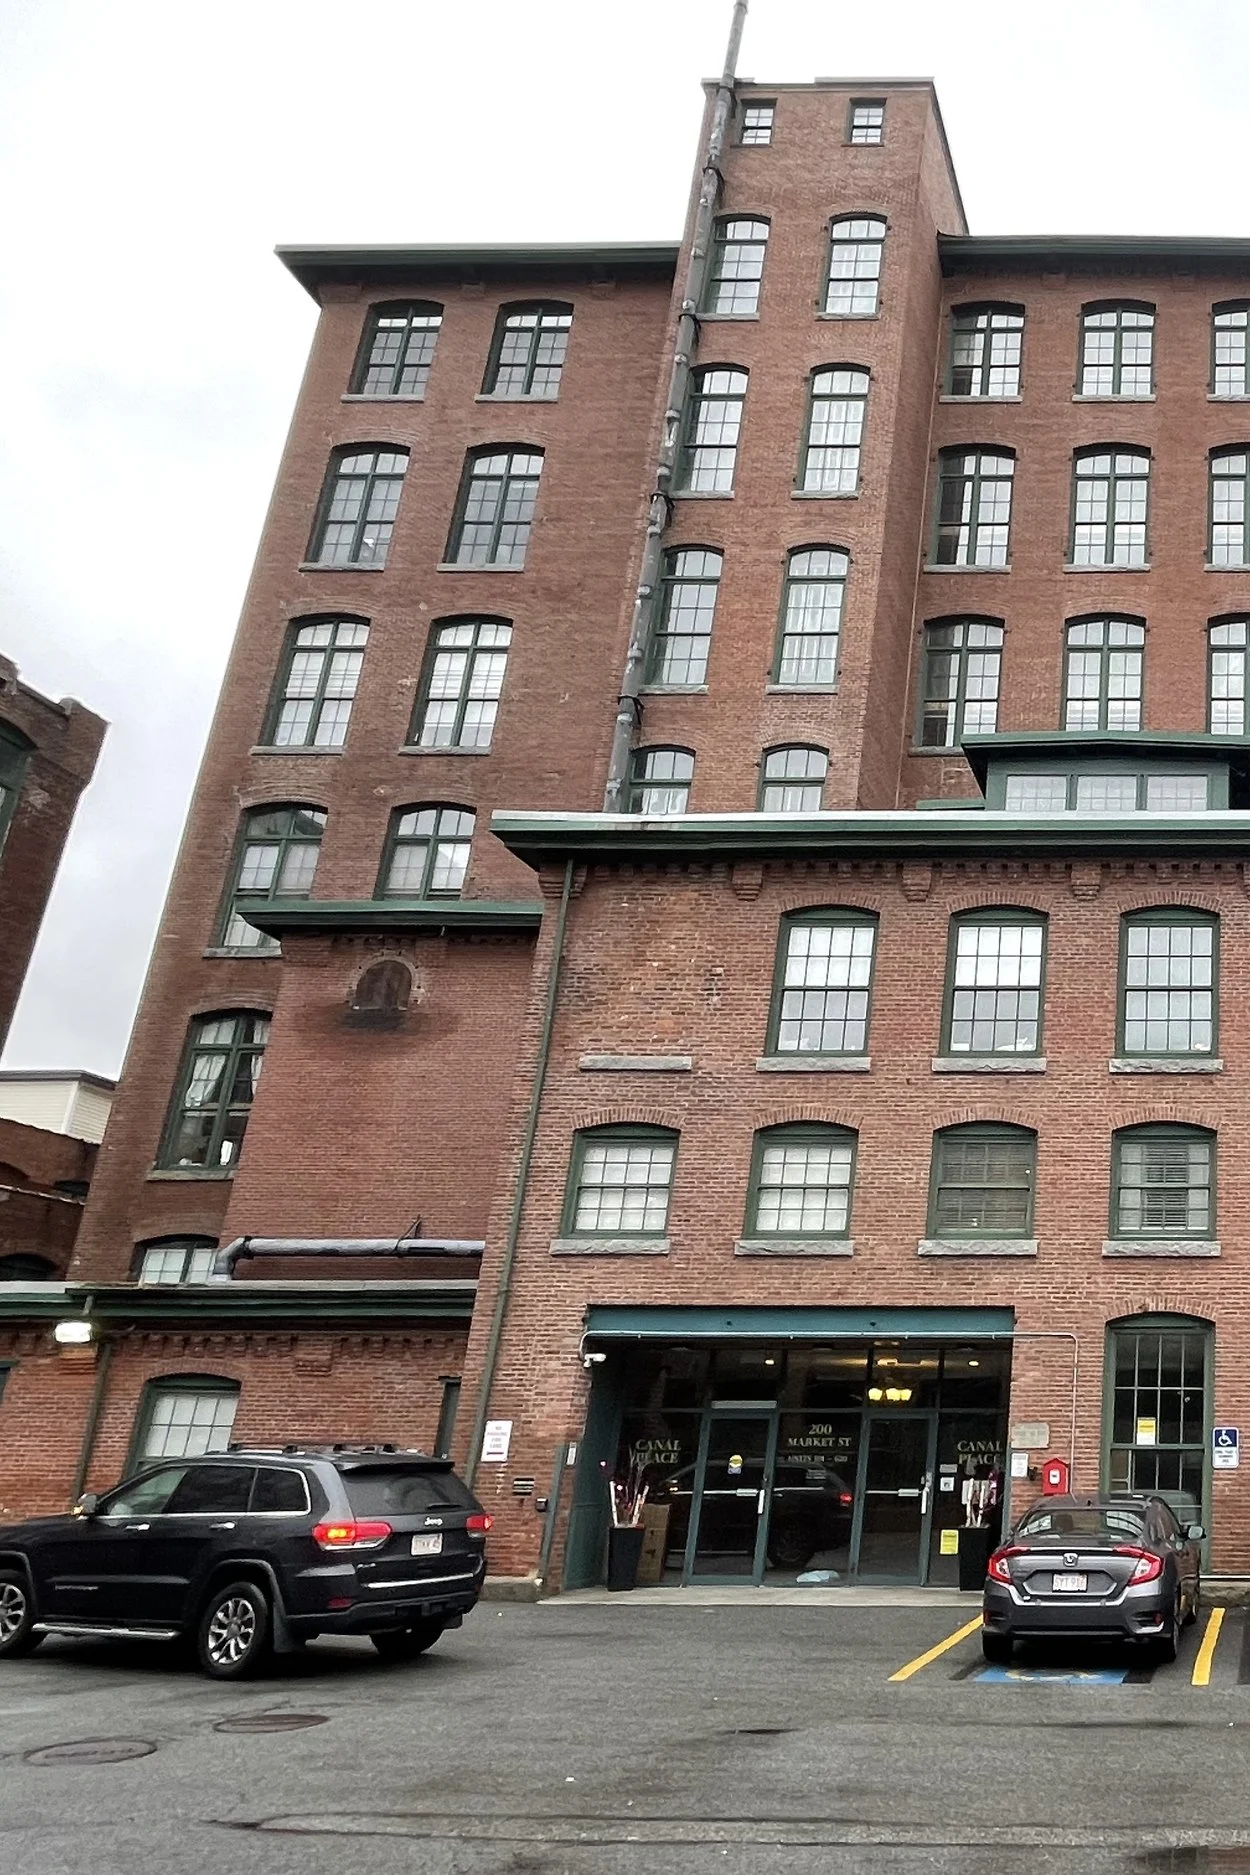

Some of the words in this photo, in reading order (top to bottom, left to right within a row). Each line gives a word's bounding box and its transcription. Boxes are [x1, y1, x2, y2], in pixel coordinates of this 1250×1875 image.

[809, 1424, 832, 1435] 200
[635, 1439, 681, 1450] CANAL
[788, 1437, 835, 1447] MARKET
[838, 1437, 851, 1447] ST
[957, 1440, 1002, 1452] CANAL
